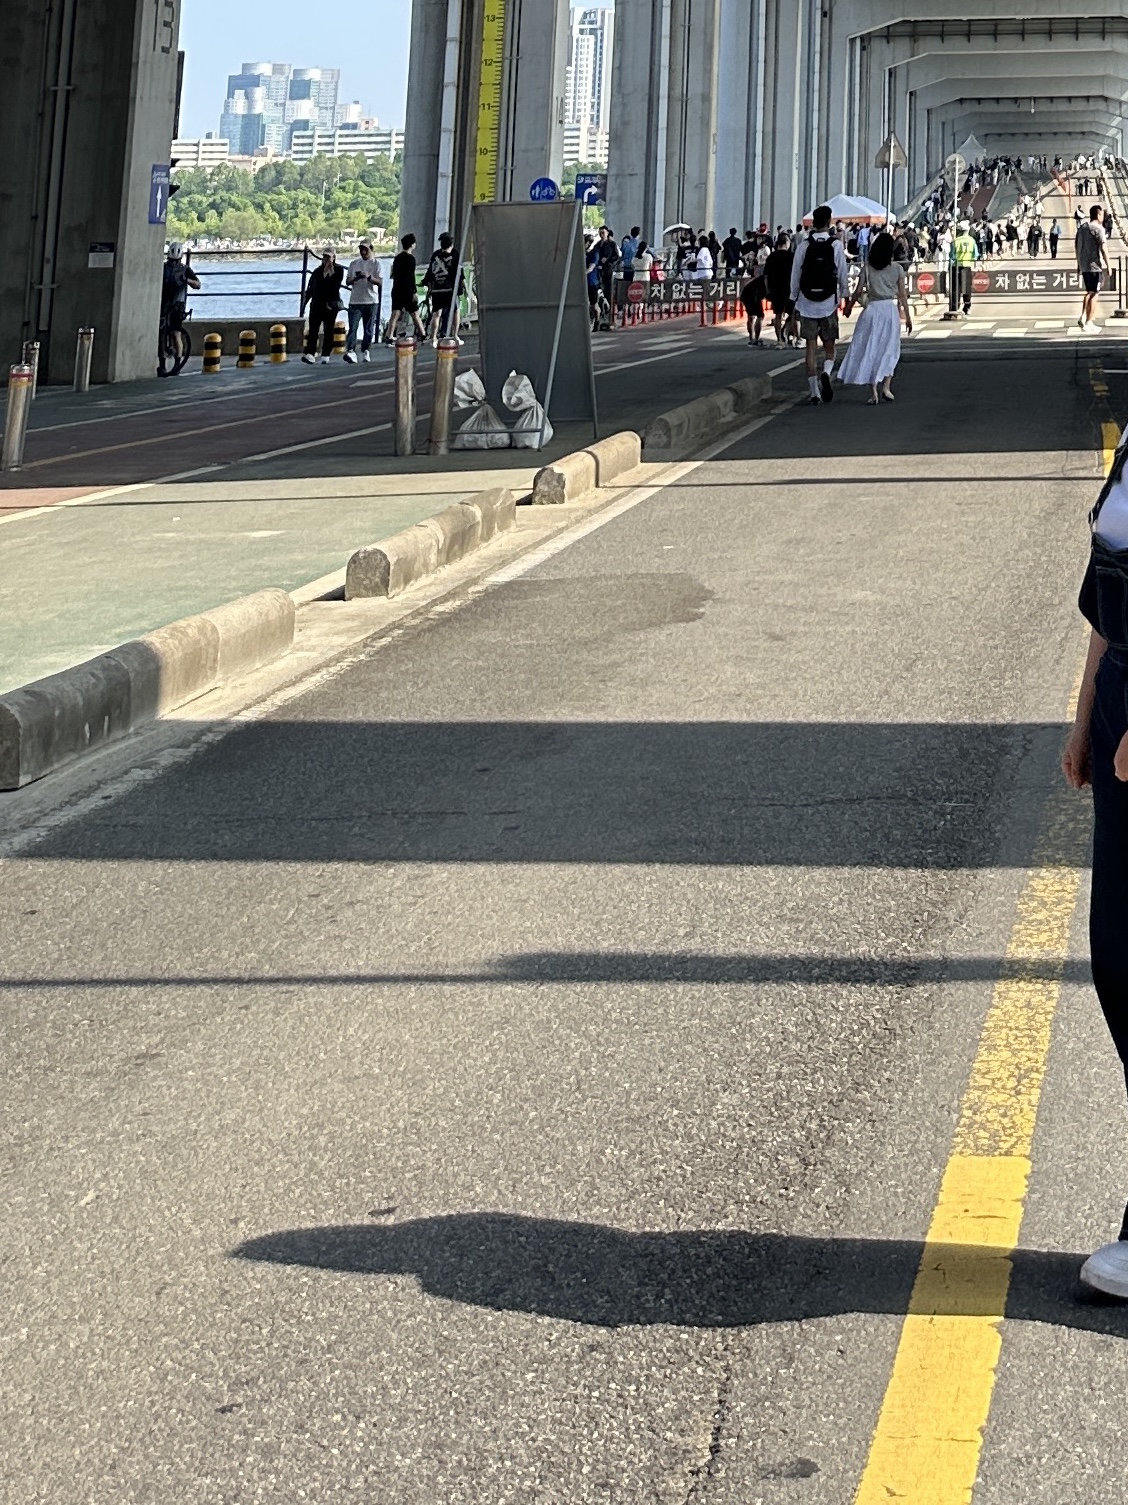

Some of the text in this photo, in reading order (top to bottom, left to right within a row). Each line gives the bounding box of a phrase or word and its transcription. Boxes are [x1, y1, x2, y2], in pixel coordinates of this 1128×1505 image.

[486, 14, 496, 22] 13
[483, 58, 493, 66] 12
[479, 147, 488, 155] 10
[995, 271, 1083, 290] 차 없는 거리
[650, 280, 740, 300] 차 없는 거리
